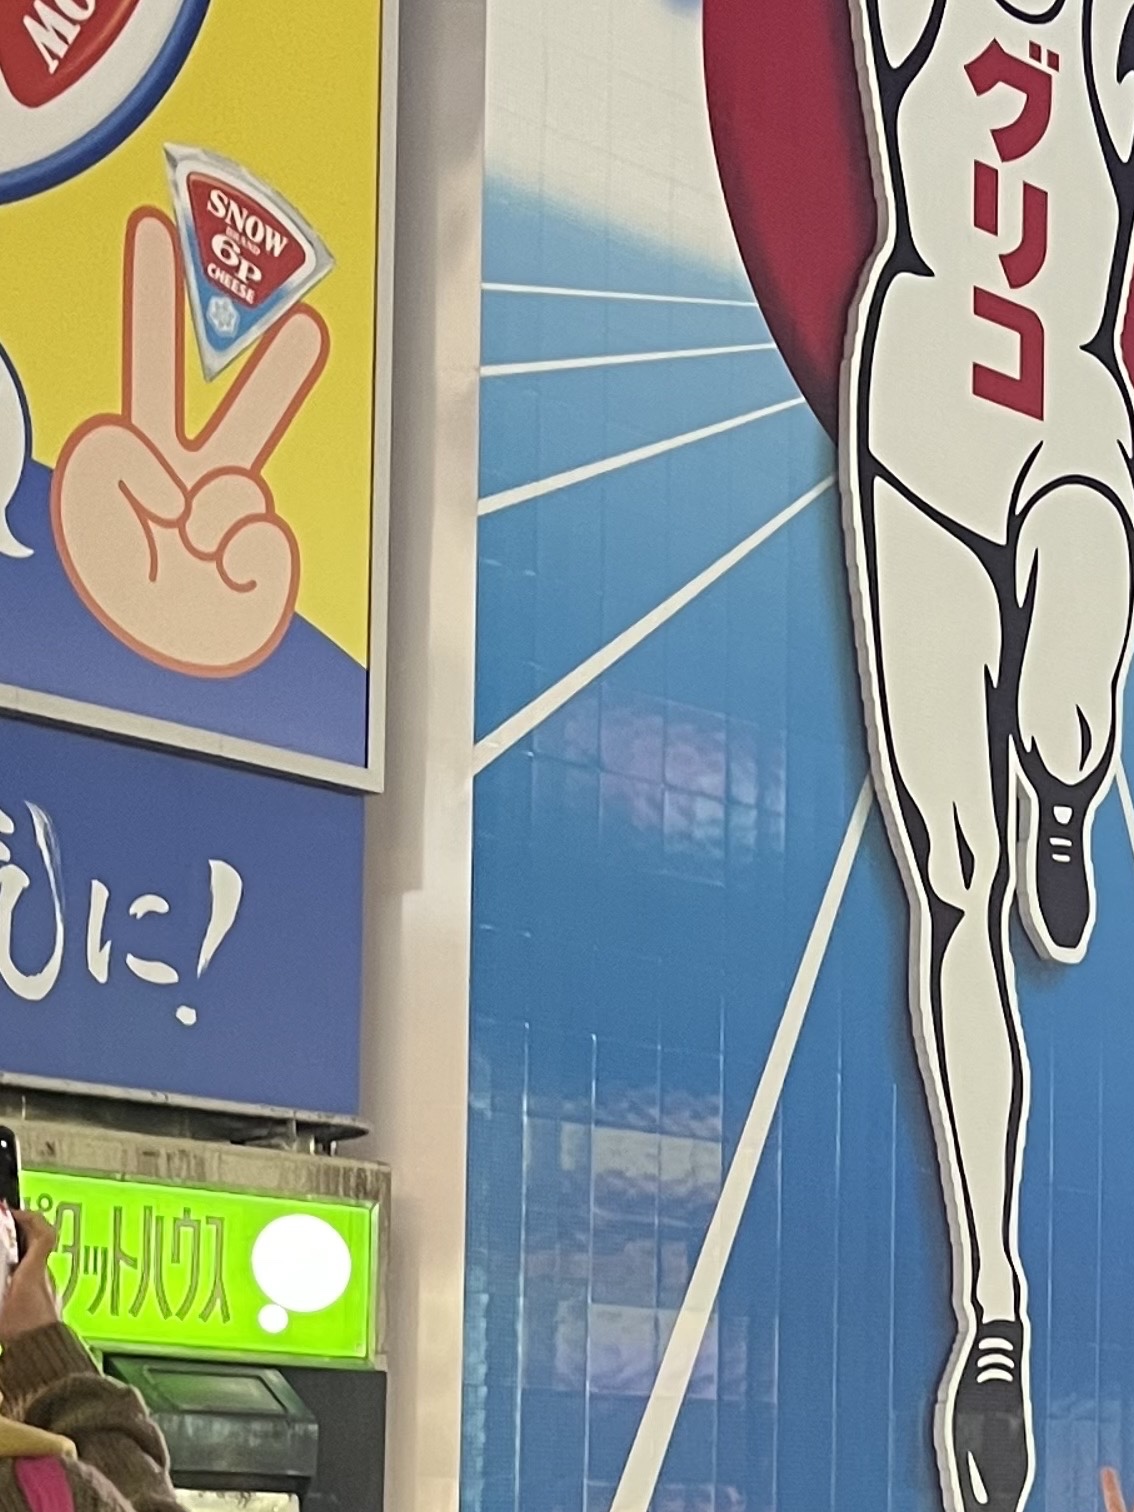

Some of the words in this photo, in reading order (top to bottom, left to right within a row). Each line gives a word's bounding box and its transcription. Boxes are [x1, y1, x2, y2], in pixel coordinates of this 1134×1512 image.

[206, 189, 289, 258] SNOW
[211, 233, 262, 283] 6P
[963, 38, 1060, 422] グリコ
[207, 263, 255, 304] CHEESE
[24, 1193, 231, 1324] タットハウス
